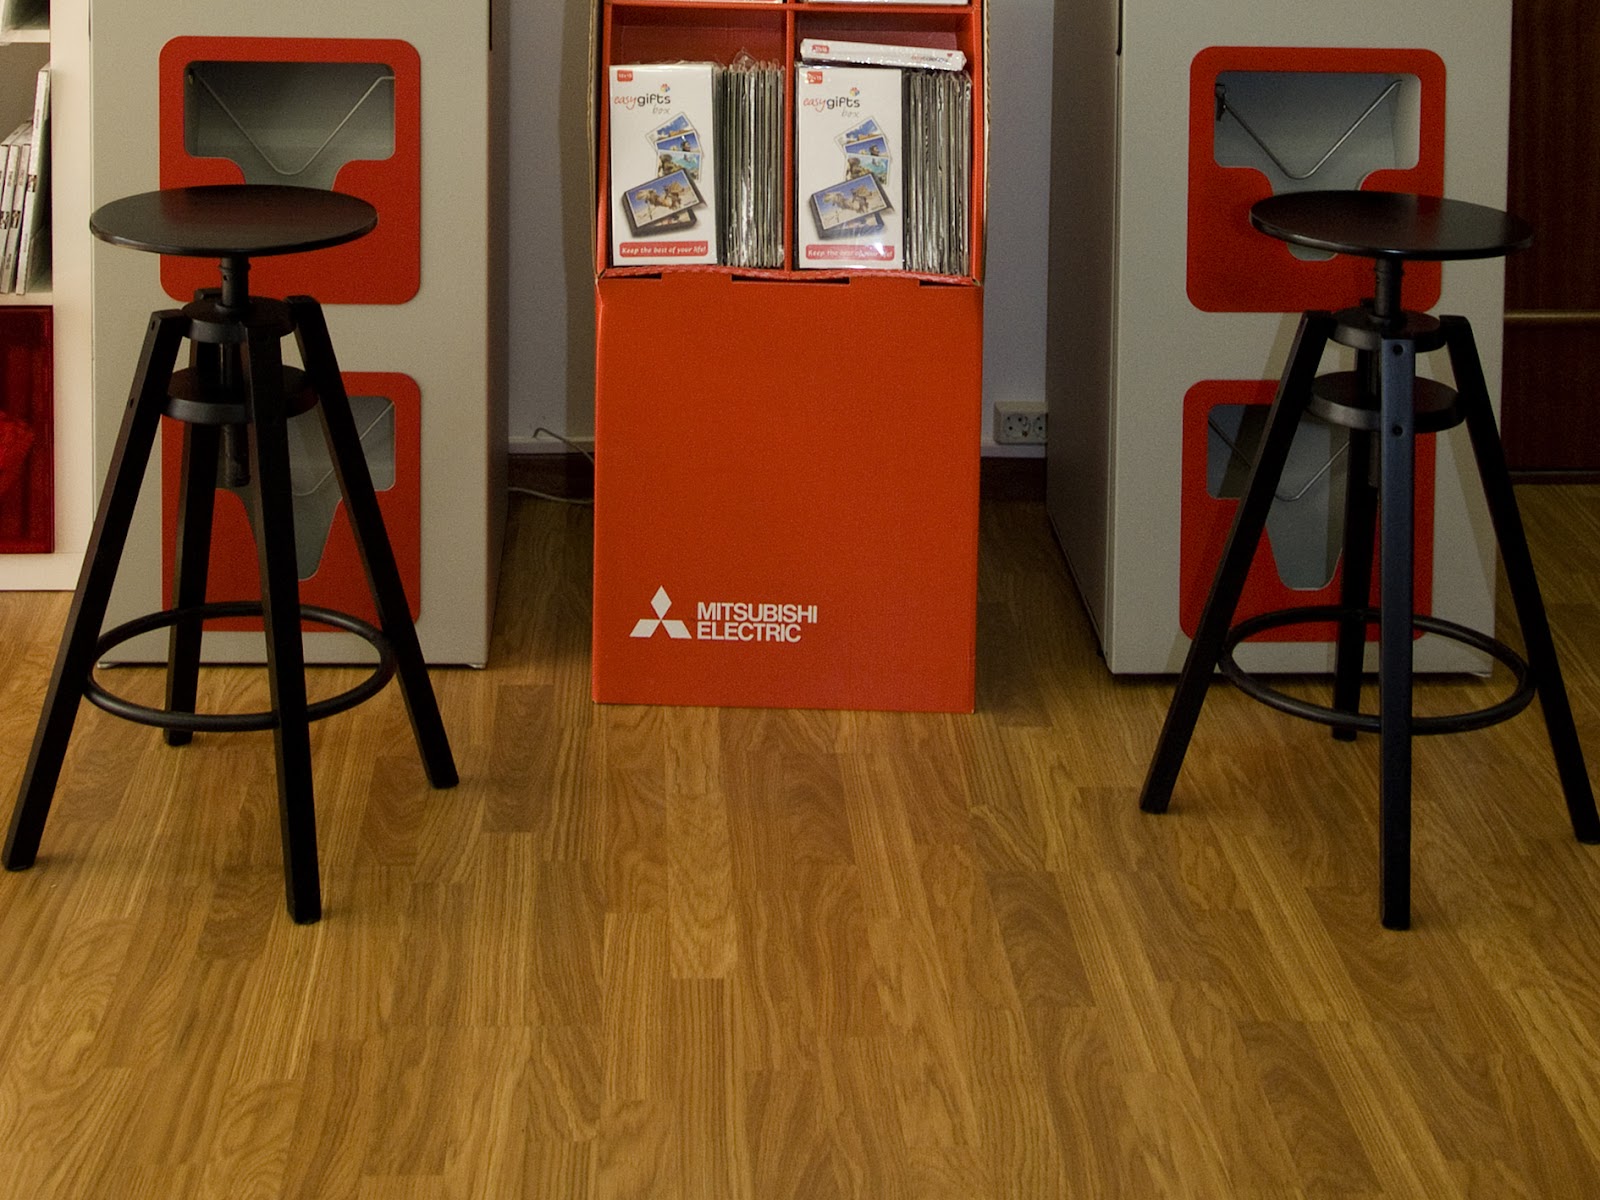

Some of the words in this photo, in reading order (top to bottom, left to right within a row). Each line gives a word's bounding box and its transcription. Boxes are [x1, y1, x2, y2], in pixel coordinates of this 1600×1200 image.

[621, 247, 639, 255] Keep
[640, 246, 651, 254] the
[653, 246, 667, 254] best
[668, 246, 676, 254] of
[697, 602, 818, 624] MITSUBISHI
[697, 621, 802, 643] ELECTRIC
